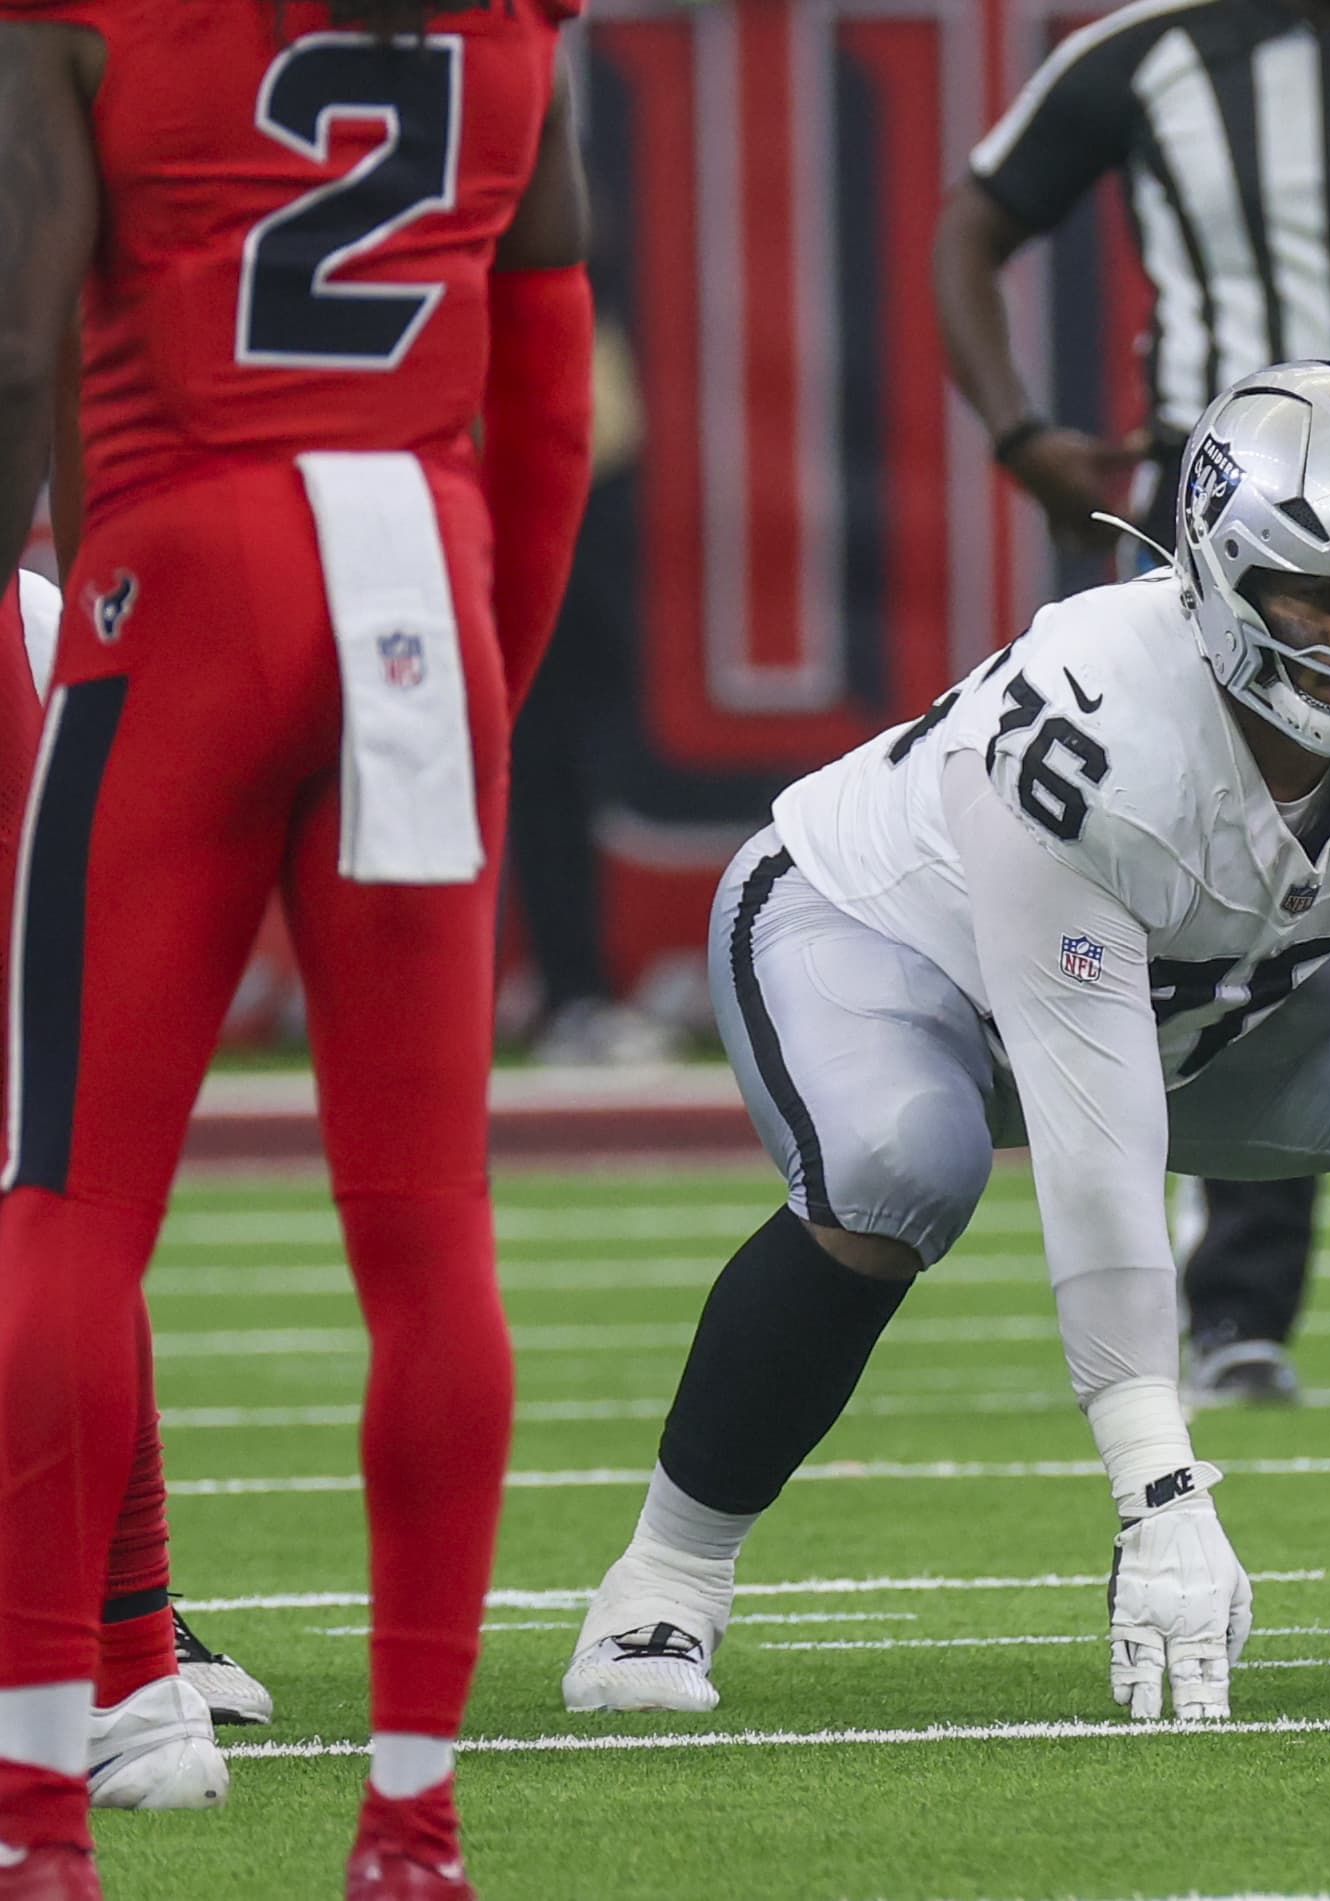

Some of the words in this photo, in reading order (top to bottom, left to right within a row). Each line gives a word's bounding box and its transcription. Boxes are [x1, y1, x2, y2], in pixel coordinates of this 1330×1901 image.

[235, 31, 463, 371] 2
[985, 668, 1109, 840] 76
[1064, 952, 1098, 979] NFL
[1145, 1466, 1195, 1508] NIKE
